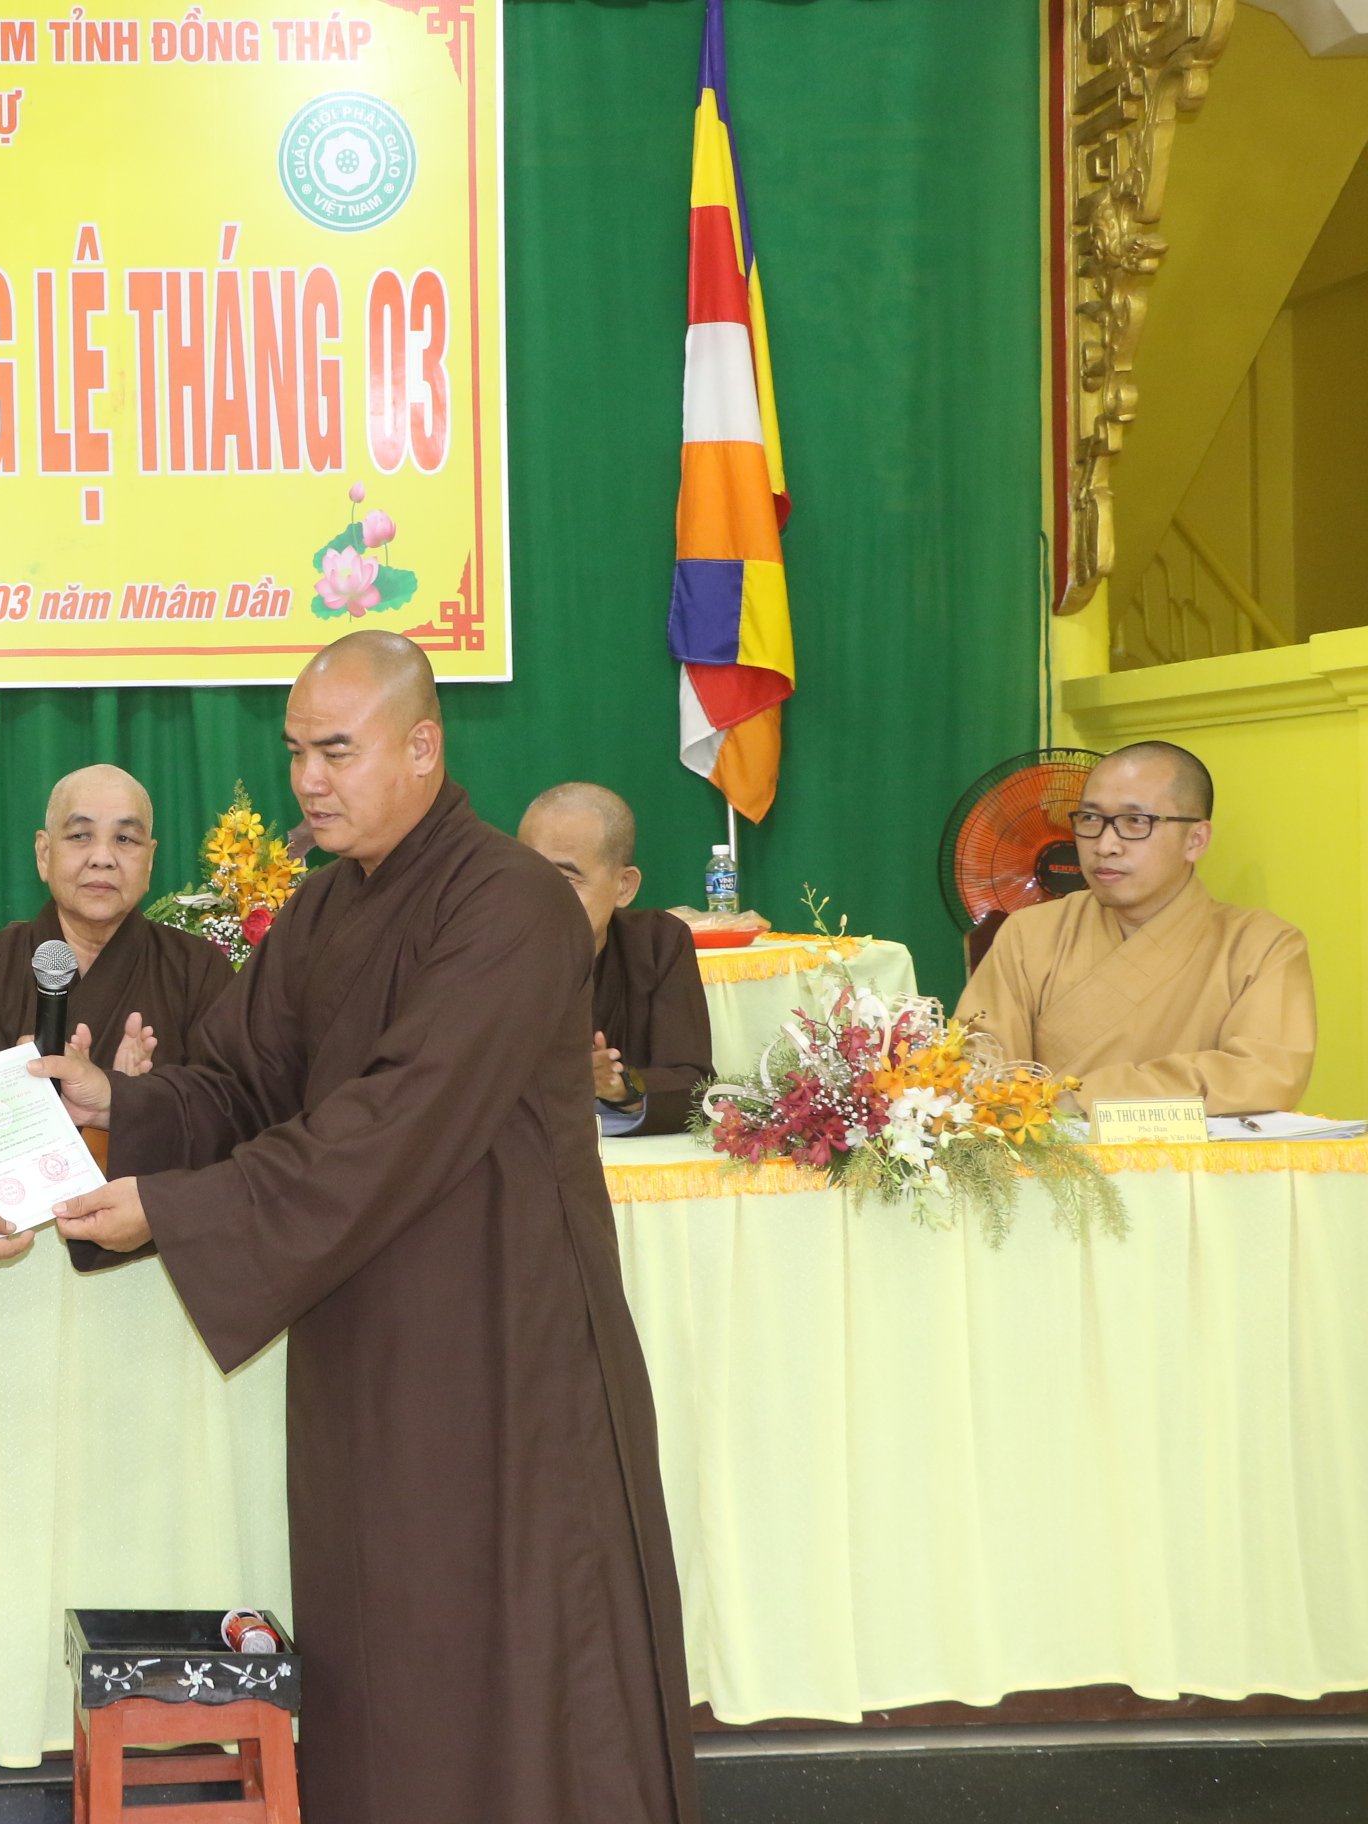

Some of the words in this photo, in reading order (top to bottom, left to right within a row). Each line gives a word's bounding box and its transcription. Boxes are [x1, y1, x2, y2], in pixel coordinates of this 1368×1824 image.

[48, 7, 139, 62] TỈNH
[150, 7, 260, 62] ĐỒNG
[272, 11, 373, 62] THÁP
[291, 134, 310, 179] GIÁO
[307, 107, 337, 133] HỘI
[342, 106, 387, 131] PHẬT
[384, 134, 405, 179] GIÁO
[313, 194, 346, 217] VIỆT
[349, 194, 383, 217] NAM
[35, 224, 112, 523] LỆ
[126, 223, 345, 475] THÁNG
[367, 268, 450, 475] 03
[38, 584, 112, 621] năm
[120, 583, 217, 620] Nhâm
[225, 576, 292, 619] Dần
